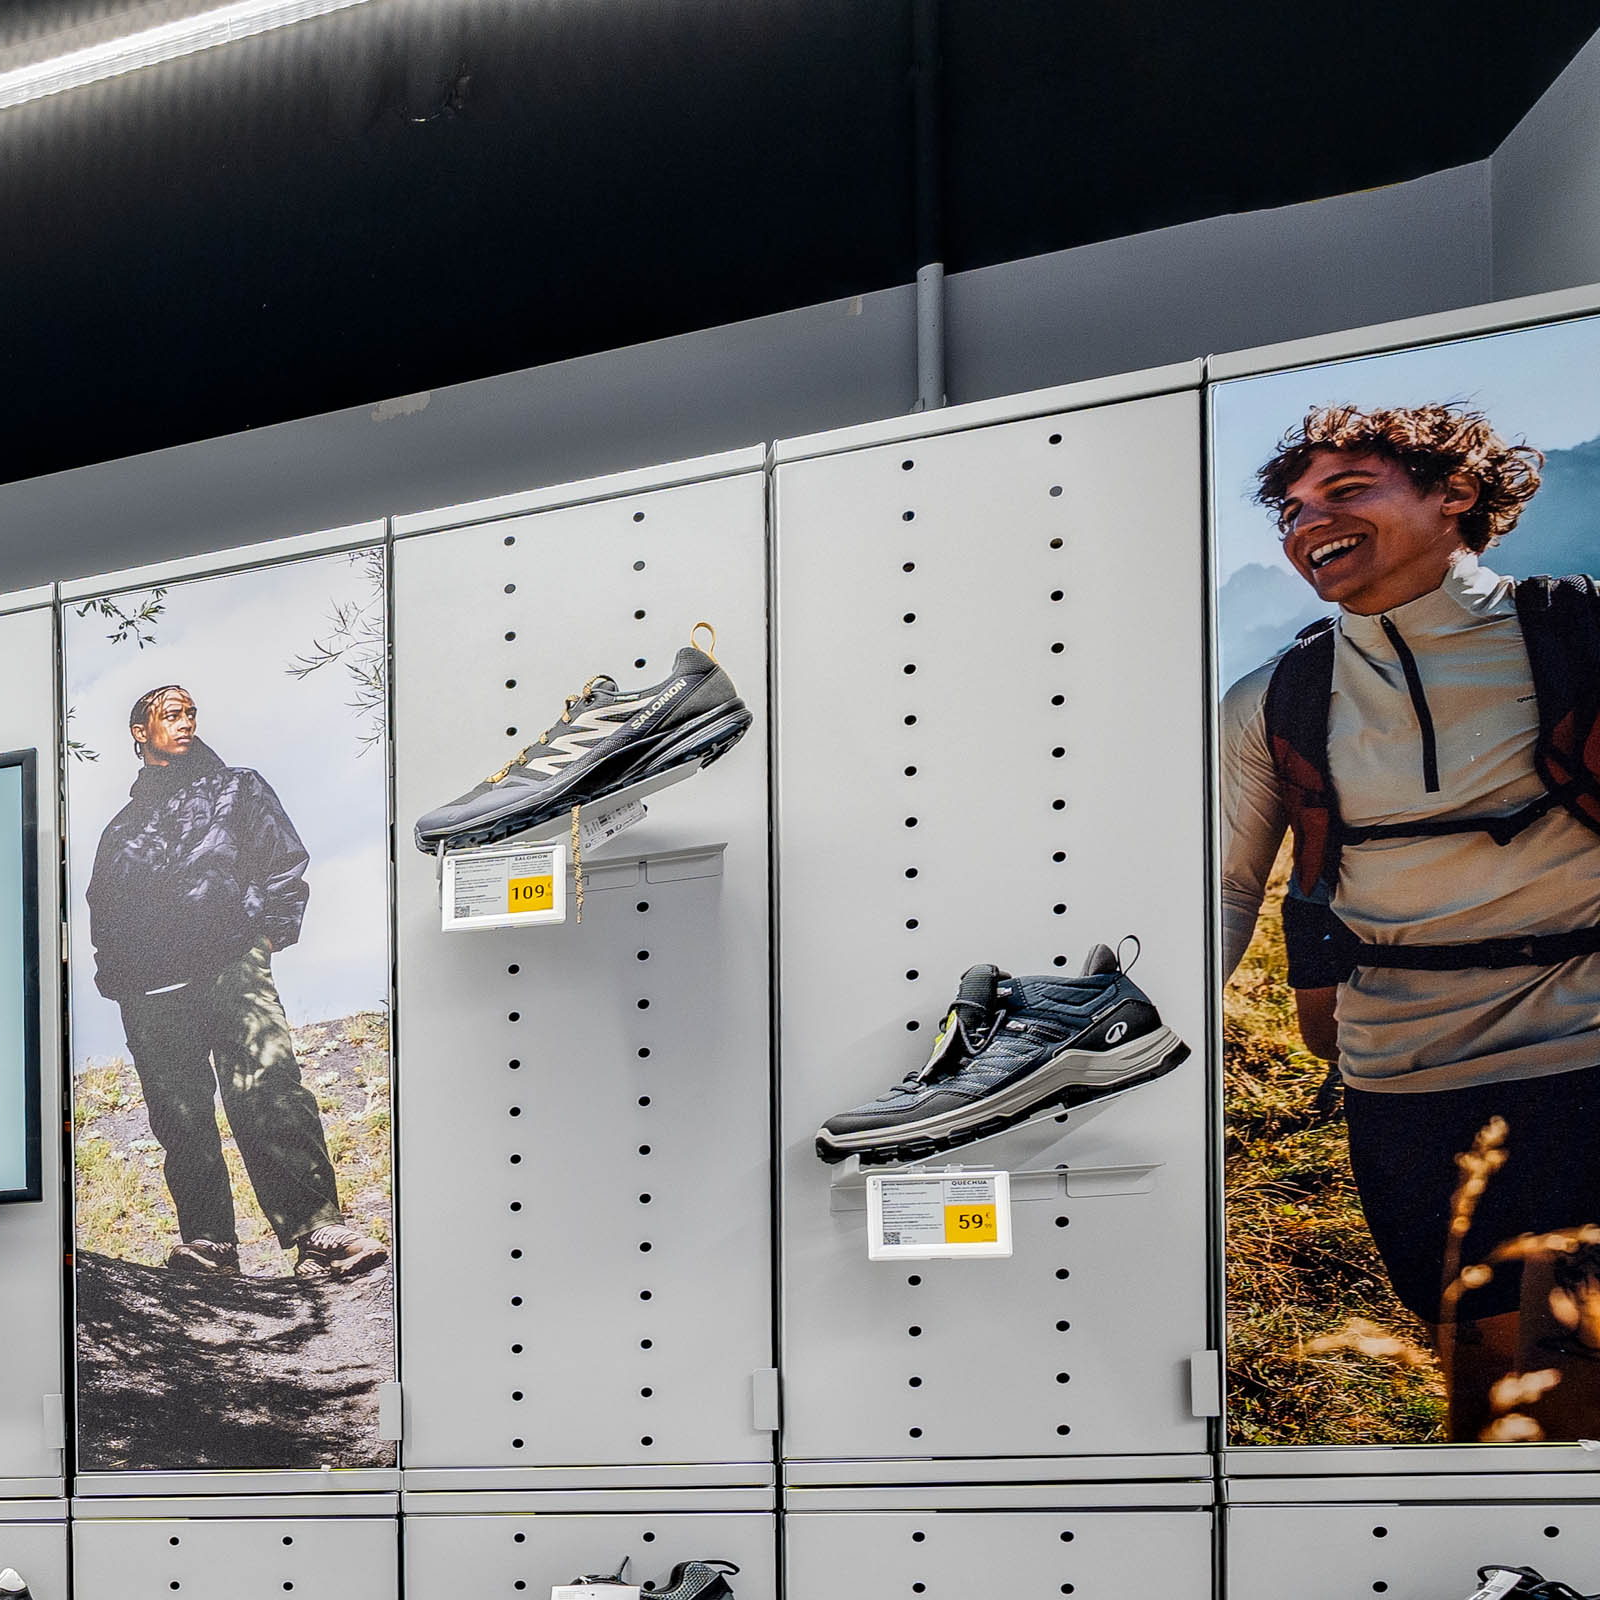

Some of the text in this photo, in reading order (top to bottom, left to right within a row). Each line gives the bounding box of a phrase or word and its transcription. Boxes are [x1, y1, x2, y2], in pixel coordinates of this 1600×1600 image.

[631, 679, 687, 730] SALOMON
[512, 885, 544, 900] 109
[959, 1214, 983, 1229] 59
